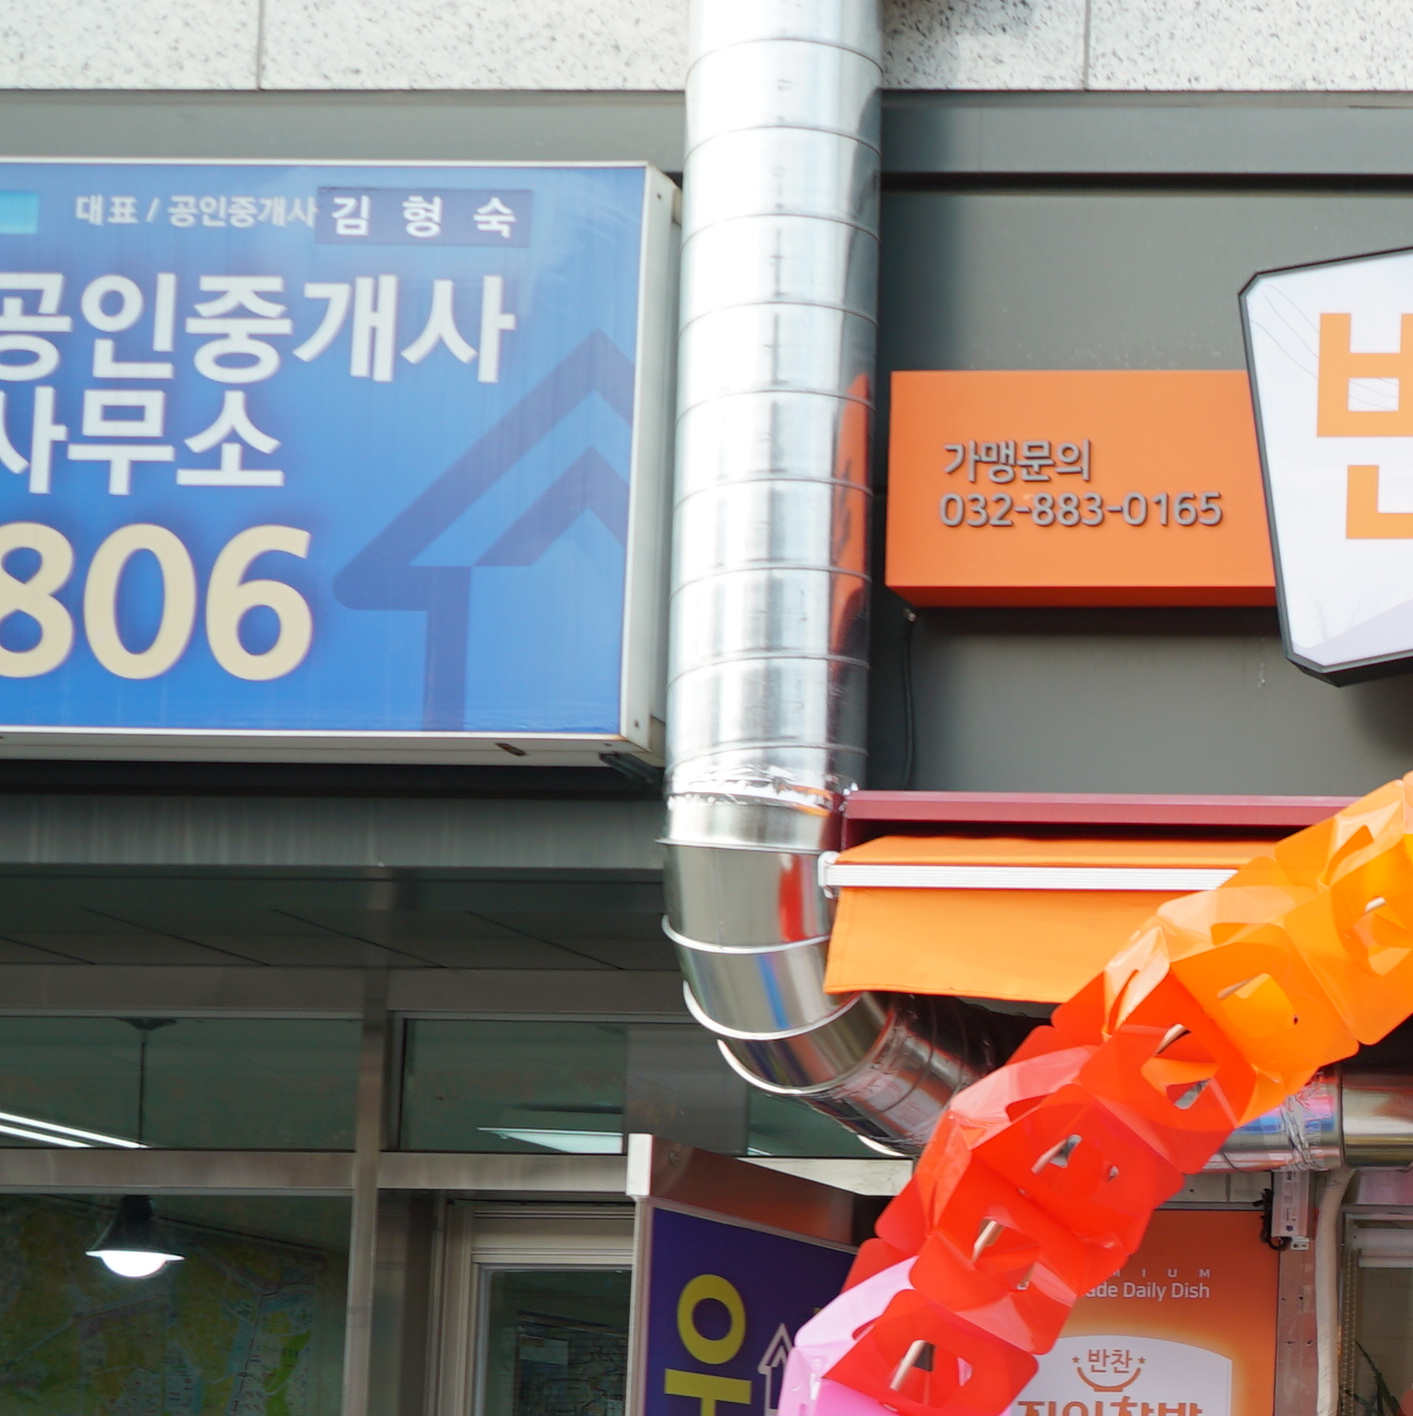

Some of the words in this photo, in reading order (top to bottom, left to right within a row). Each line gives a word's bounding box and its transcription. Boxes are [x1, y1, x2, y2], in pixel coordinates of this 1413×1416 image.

[76, 198, 138, 227] 대표
[168, 197, 317, 229] 공인중개사
[943, 439, 1093, 483] 가맹문의
[940, 491, 1224, 528] 032-883-0165
[1123, 1282, 1167, 1302] Daily
[1171, 1282, 1210, 1298] Dish
[1088, 1349, 1133, 1374] 반찬
